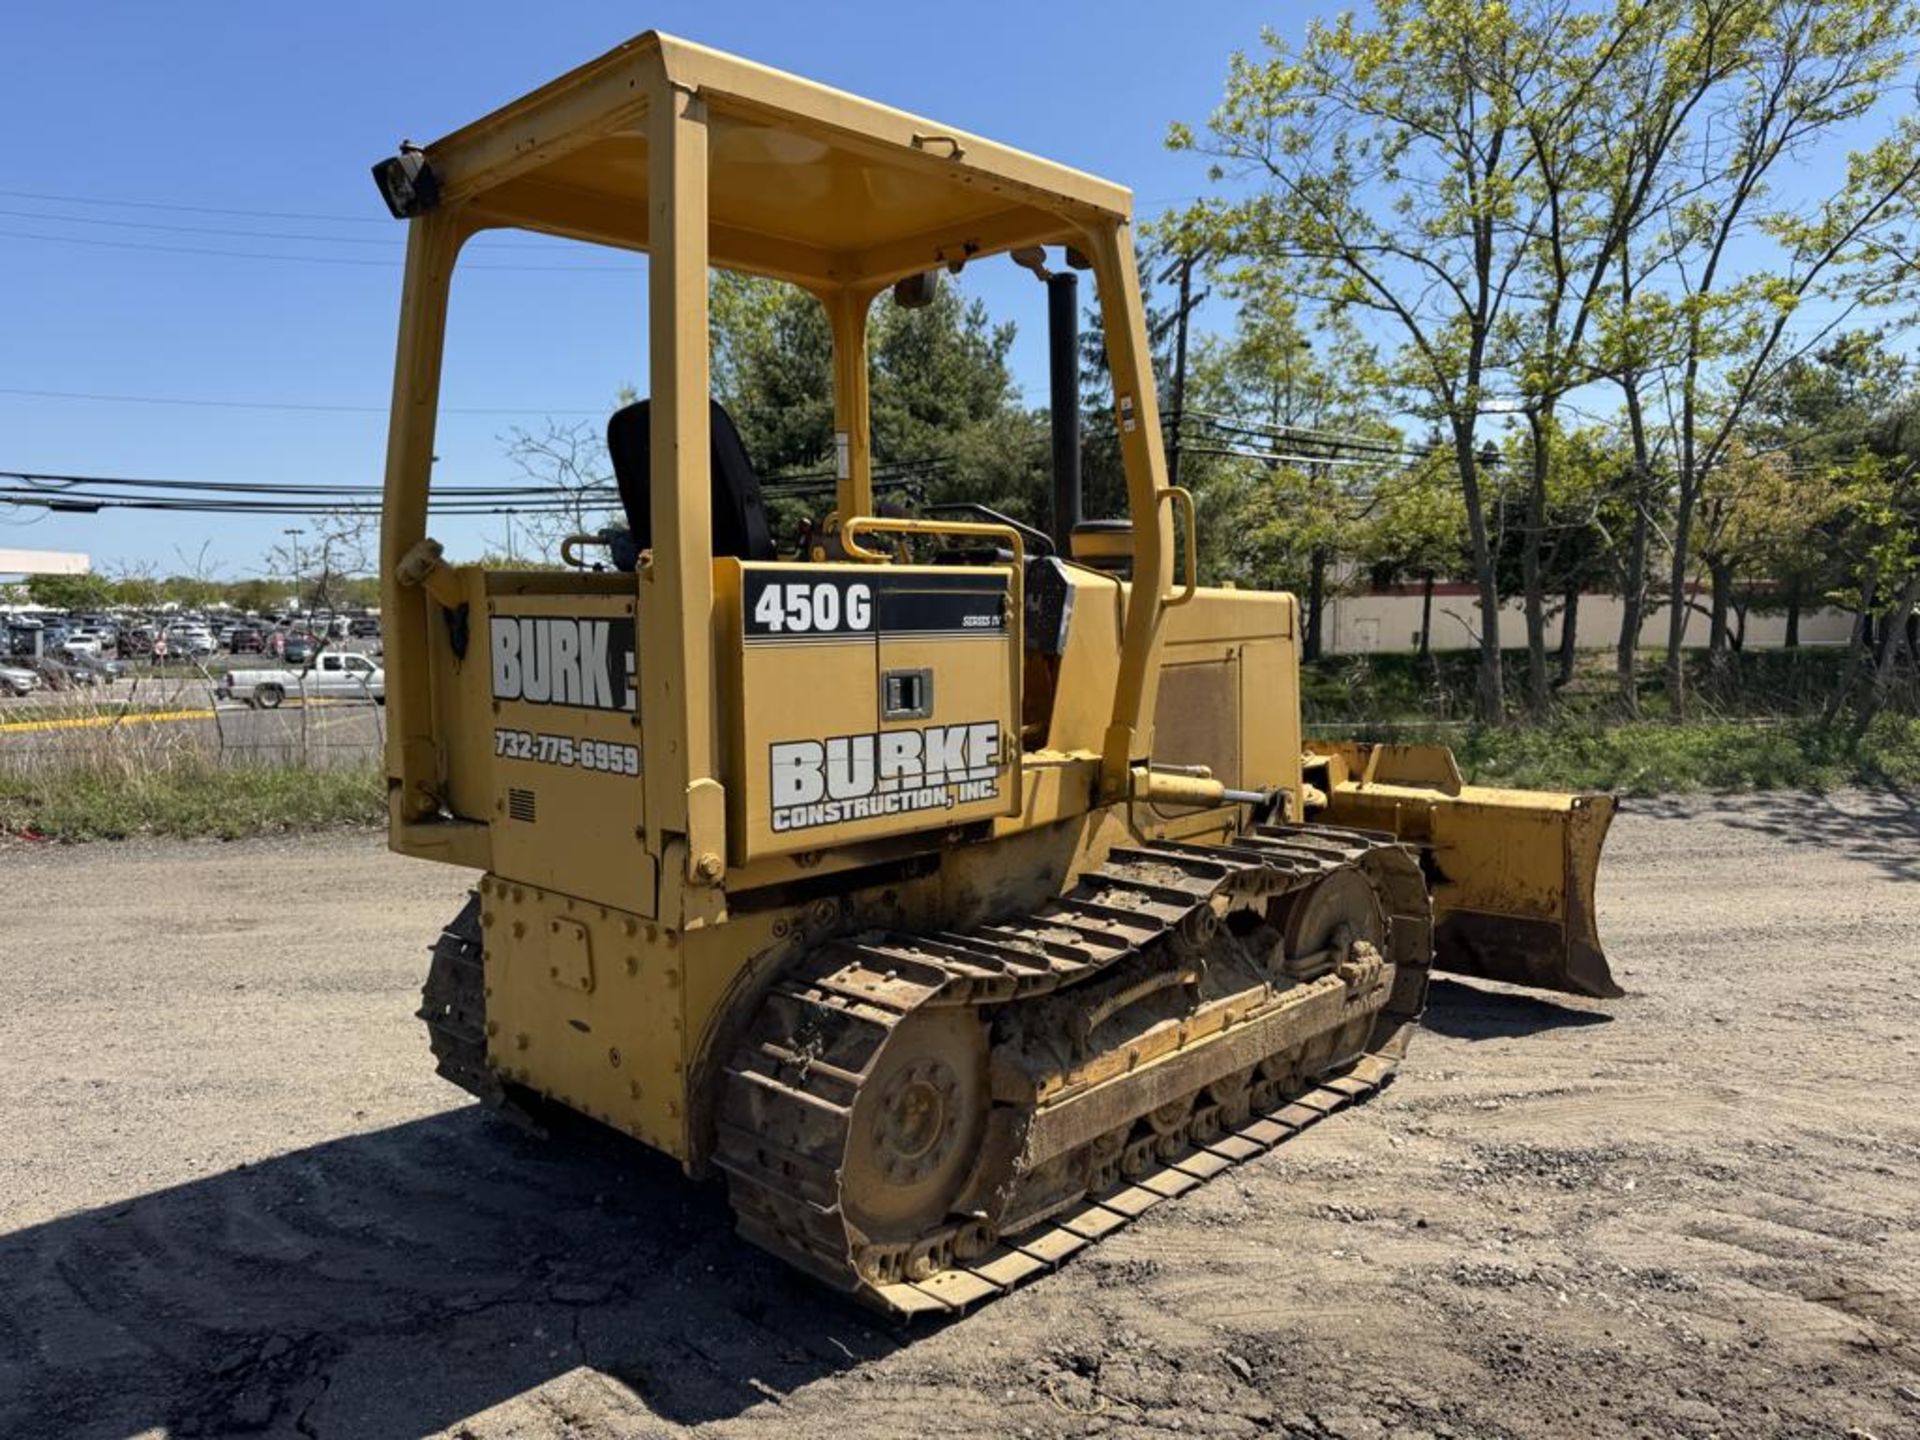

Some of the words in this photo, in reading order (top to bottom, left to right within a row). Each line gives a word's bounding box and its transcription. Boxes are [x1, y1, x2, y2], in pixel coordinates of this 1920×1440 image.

[755, 582, 840, 632] 450
[846, 583, 871, 631] G
[495, 729, 640, 776] 732-775-6959
[771, 722, 999, 808] BURKE
[772, 784, 955, 831] CONSTRUCTION,
[959, 779, 999, 803] INC.
